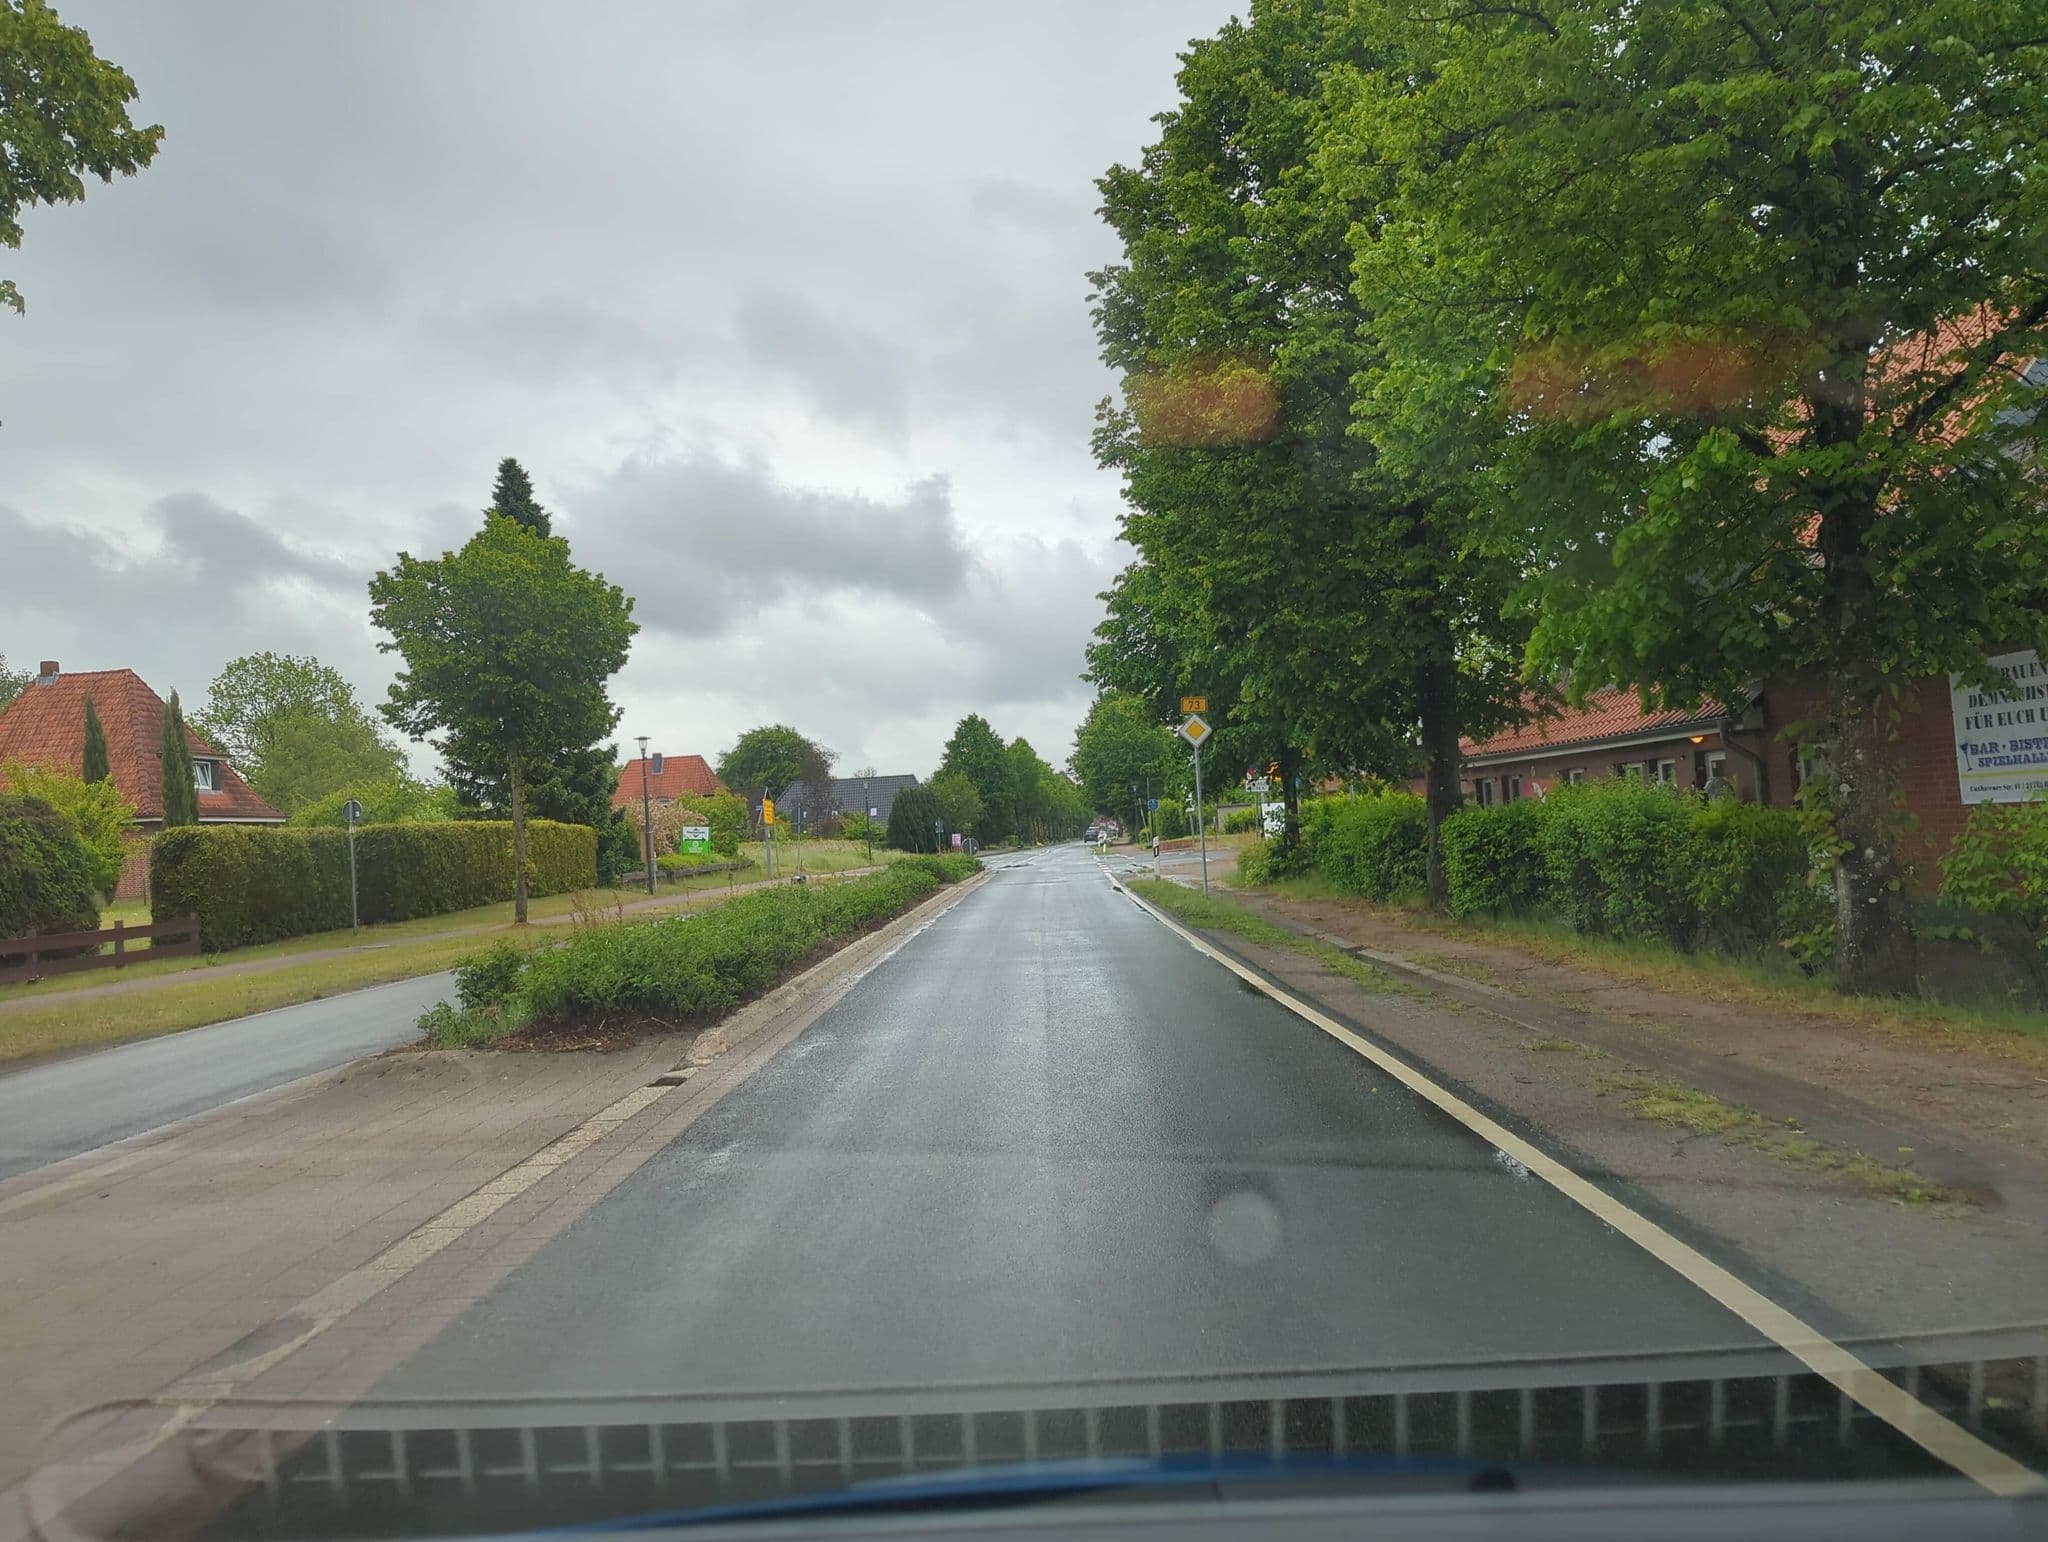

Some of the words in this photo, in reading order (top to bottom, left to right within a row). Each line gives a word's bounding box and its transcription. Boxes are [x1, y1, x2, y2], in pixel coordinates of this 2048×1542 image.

[1968, 684, 2048, 709] DEMNHS
[1188, 700, 1201, 710] 73
[1965, 711, 1993, 730] FÜR
[1997, 708, 2036, 727] EUCH
[1970, 742, 2000, 755] BAR
[1978, 752, 2048, 768] SPIELHALL
